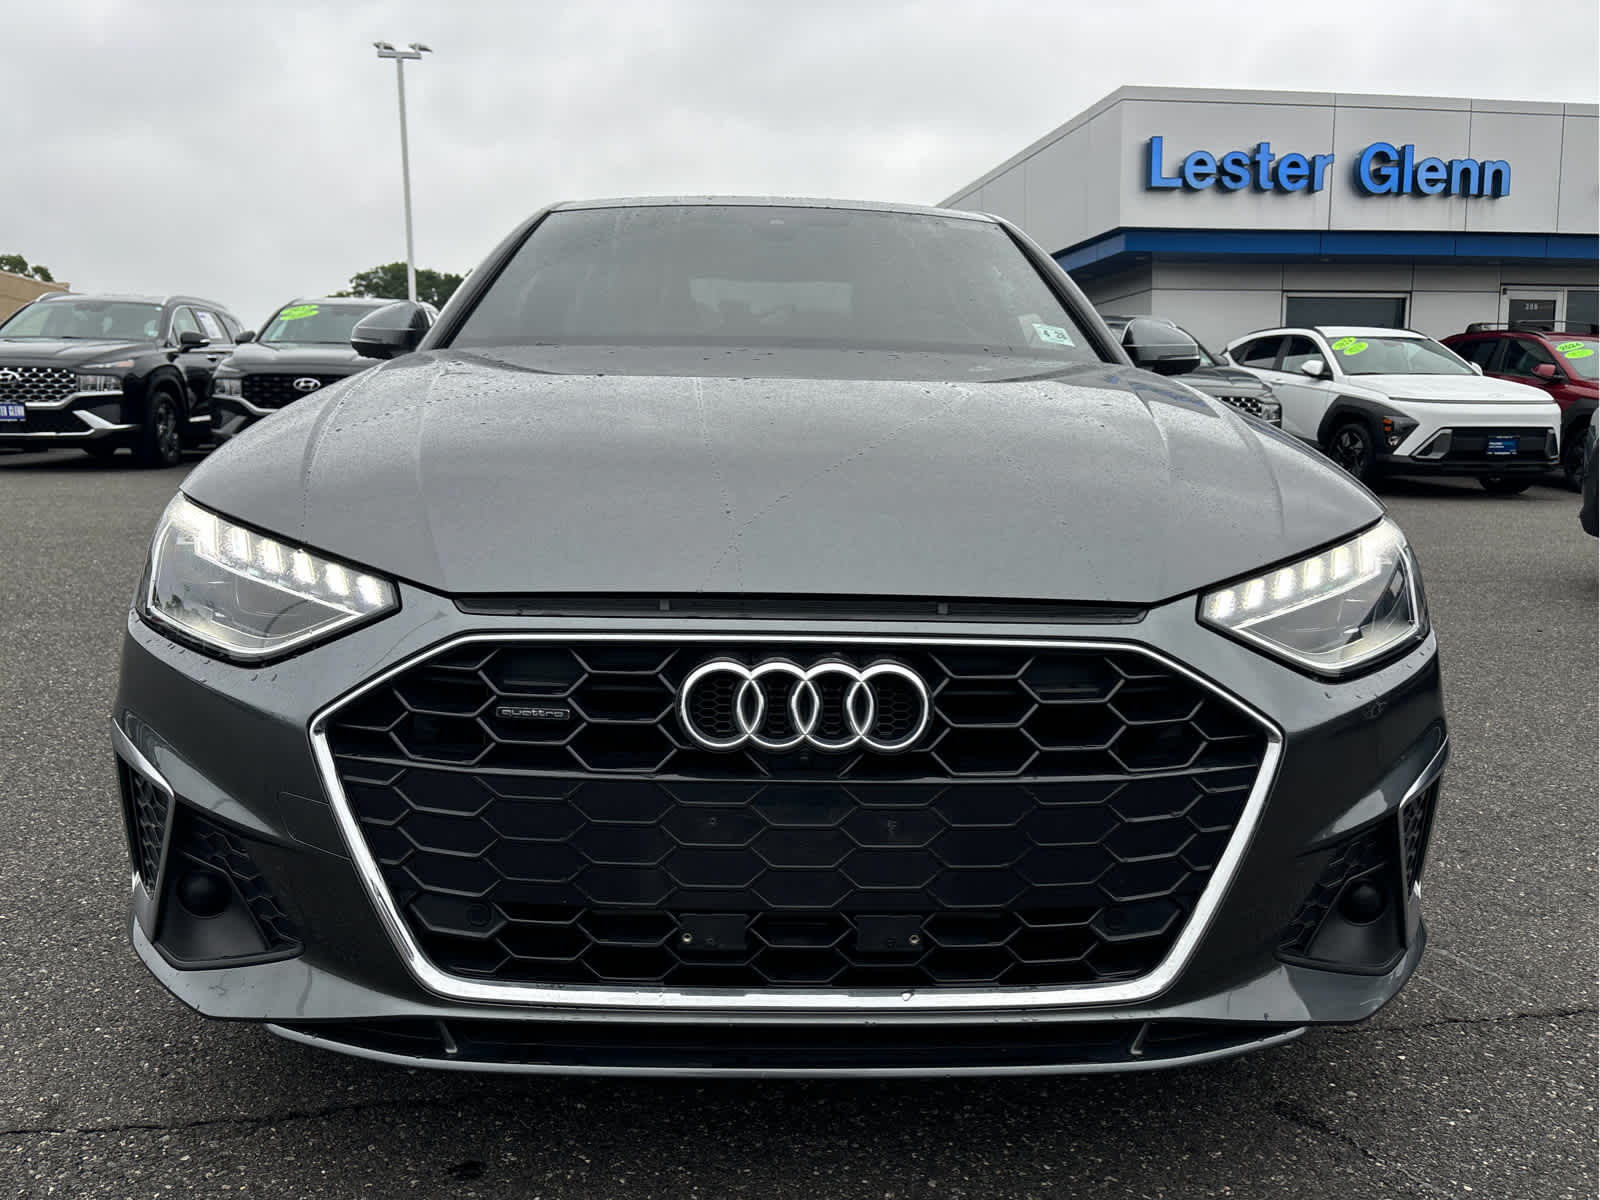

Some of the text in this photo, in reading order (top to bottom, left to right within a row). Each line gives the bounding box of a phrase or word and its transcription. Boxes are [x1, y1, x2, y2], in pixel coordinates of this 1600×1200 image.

[1147, 136, 1511, 198] Lester Glenn
[501, 708, 564, 718] quattro
